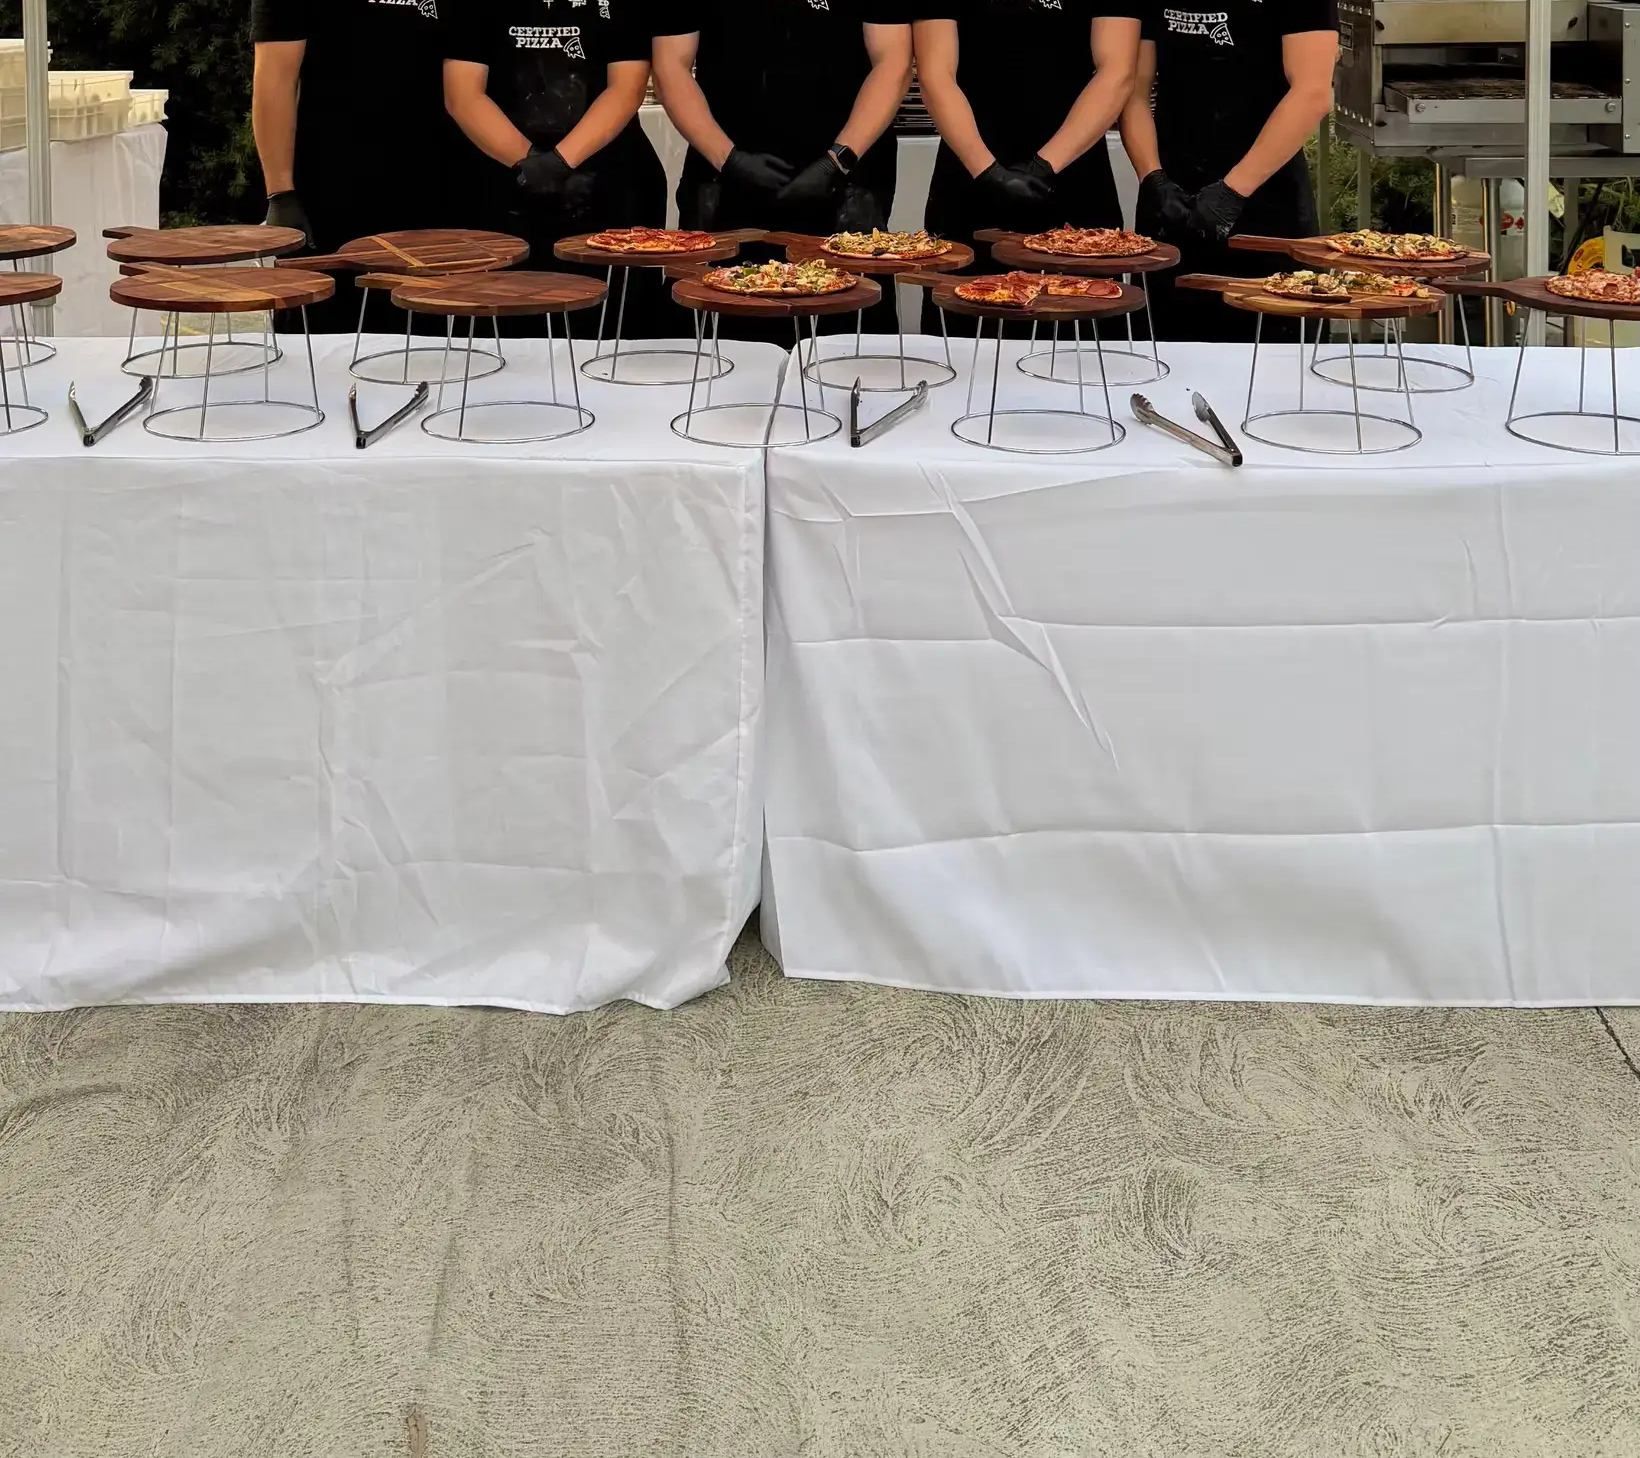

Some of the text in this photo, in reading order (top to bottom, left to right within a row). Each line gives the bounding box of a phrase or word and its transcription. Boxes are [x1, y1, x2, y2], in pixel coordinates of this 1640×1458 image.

[1164, 9, 1229, 23] CERTIFIED
[509, 26, 581, 38] CERTIFIED
[1168, 20, 1210, 34] PIZZA
[515, 37, 564, 49] PIZZA
